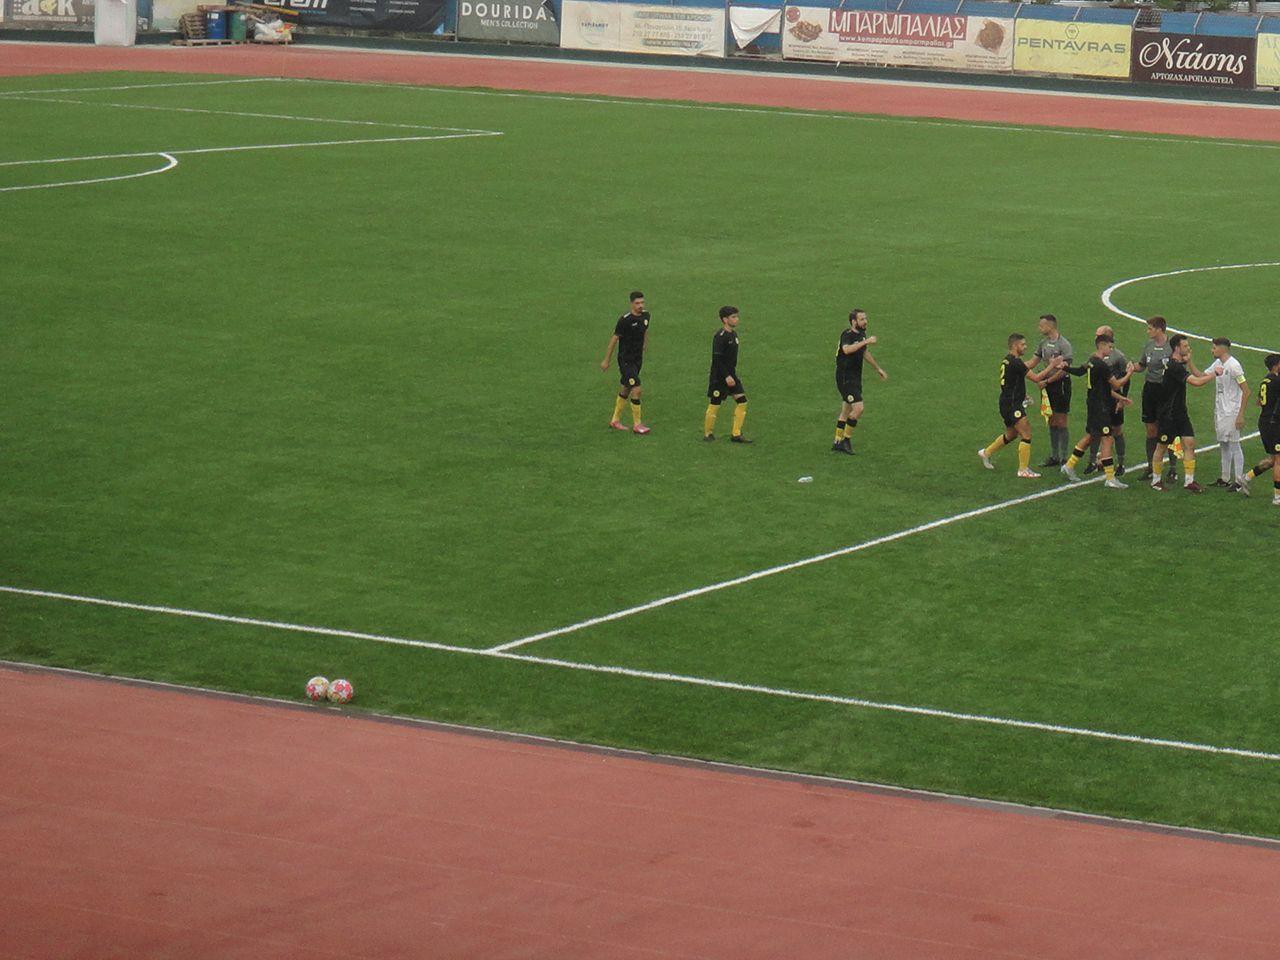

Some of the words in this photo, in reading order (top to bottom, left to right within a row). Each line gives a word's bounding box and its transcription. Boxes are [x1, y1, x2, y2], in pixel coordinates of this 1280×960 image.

[501, 20, 538, 29] COLLECTION
[831, 10, 965, 39] ΜΠΑΡΜΠΑΛΙΑΣ
[1017, 38, 1126, 54] PENTAVRAS
